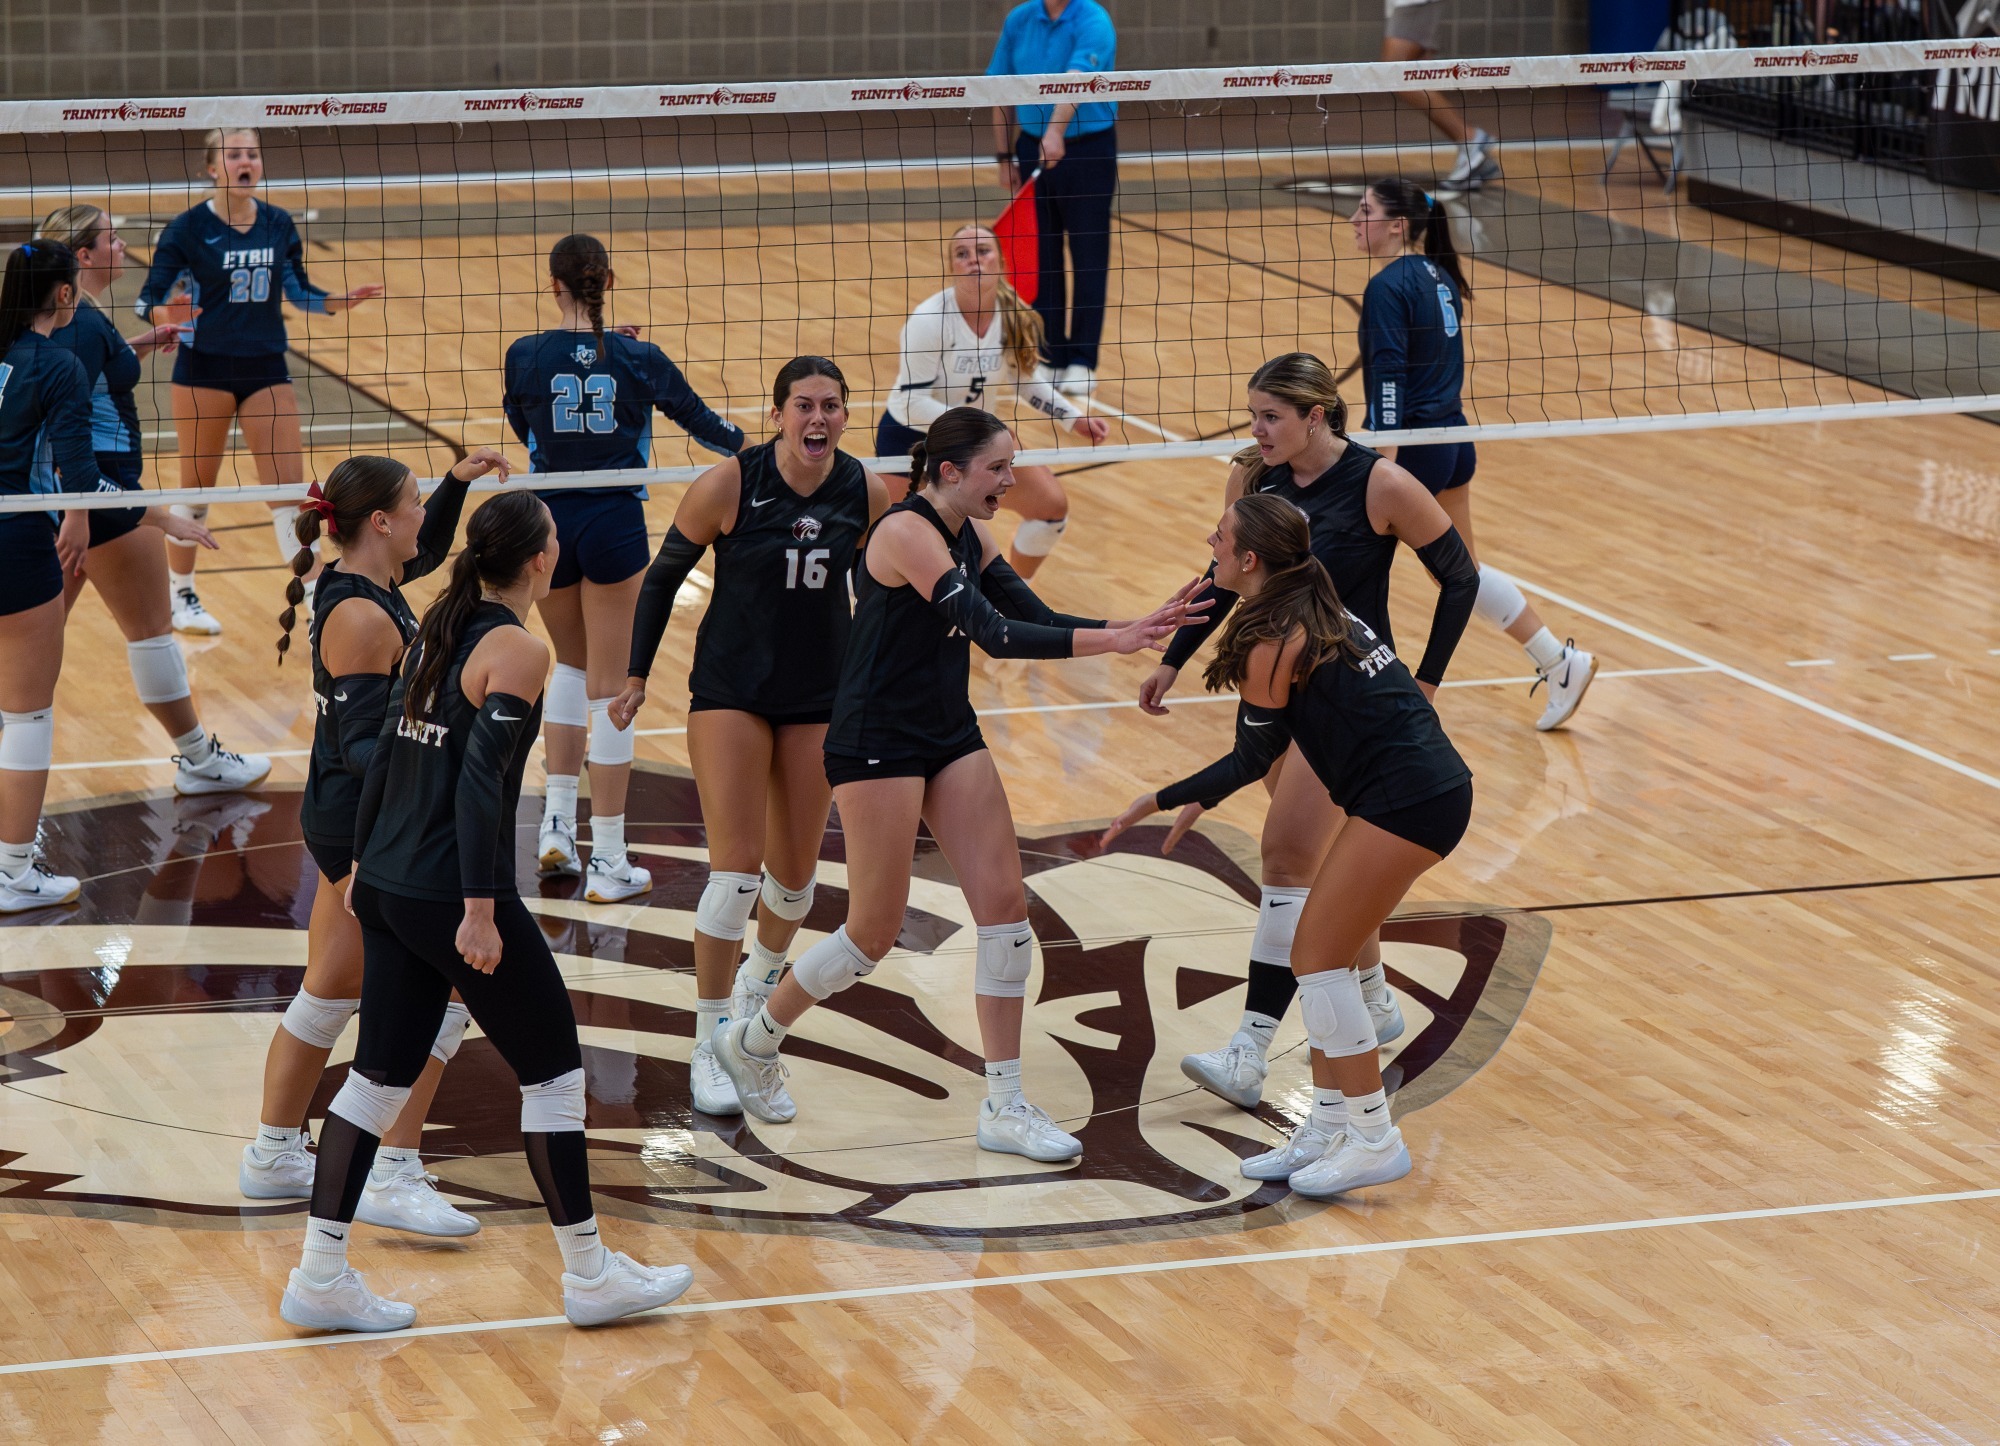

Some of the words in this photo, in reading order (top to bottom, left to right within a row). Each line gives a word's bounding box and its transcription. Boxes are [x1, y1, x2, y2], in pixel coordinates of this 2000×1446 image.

[1754, 57, 1803, 68] TRINITY
[1818, 54, 1859, 65] TIGERS
[1924, 49, 1971, 60] TRINITY
[1403, 68, 1453, 81] TRINITY
[1469, 66, 1511, 77] TIGERS
[1580, 62, 1629, 73] TRINITY
[1644, 60, 1686, 71] TIGERS
[1039, 82, 1091, 95] TRINITY
[1108, 80, 1152, 92] TIGERS
[1223, 76, 1274, 87] TRINITY
[1290, 74, 1333, 85] TIGERS
[659, 94, 714, 106] TRINITY
[732, 92, 776, 104] TIGERS
[851, 89, 904, 100] TRINITY
[921, 87, 966, 98] TIGERS
[265, 104, 321, 116] TRINITY
[341, 102, 387, 114] TIGERS
[464, 99, 520, 111] TRINITY
[538, 98, 584, 109] TIGERS
[62, 109, 119, 120] TRINITY
[139, 107, 186, 119] TIGERS
[229, 267, 272, 303] 20
[965, 376, 986, 404] 5
[551, 373, 619, 434] 23
[786, 548, 830, 589] 16
